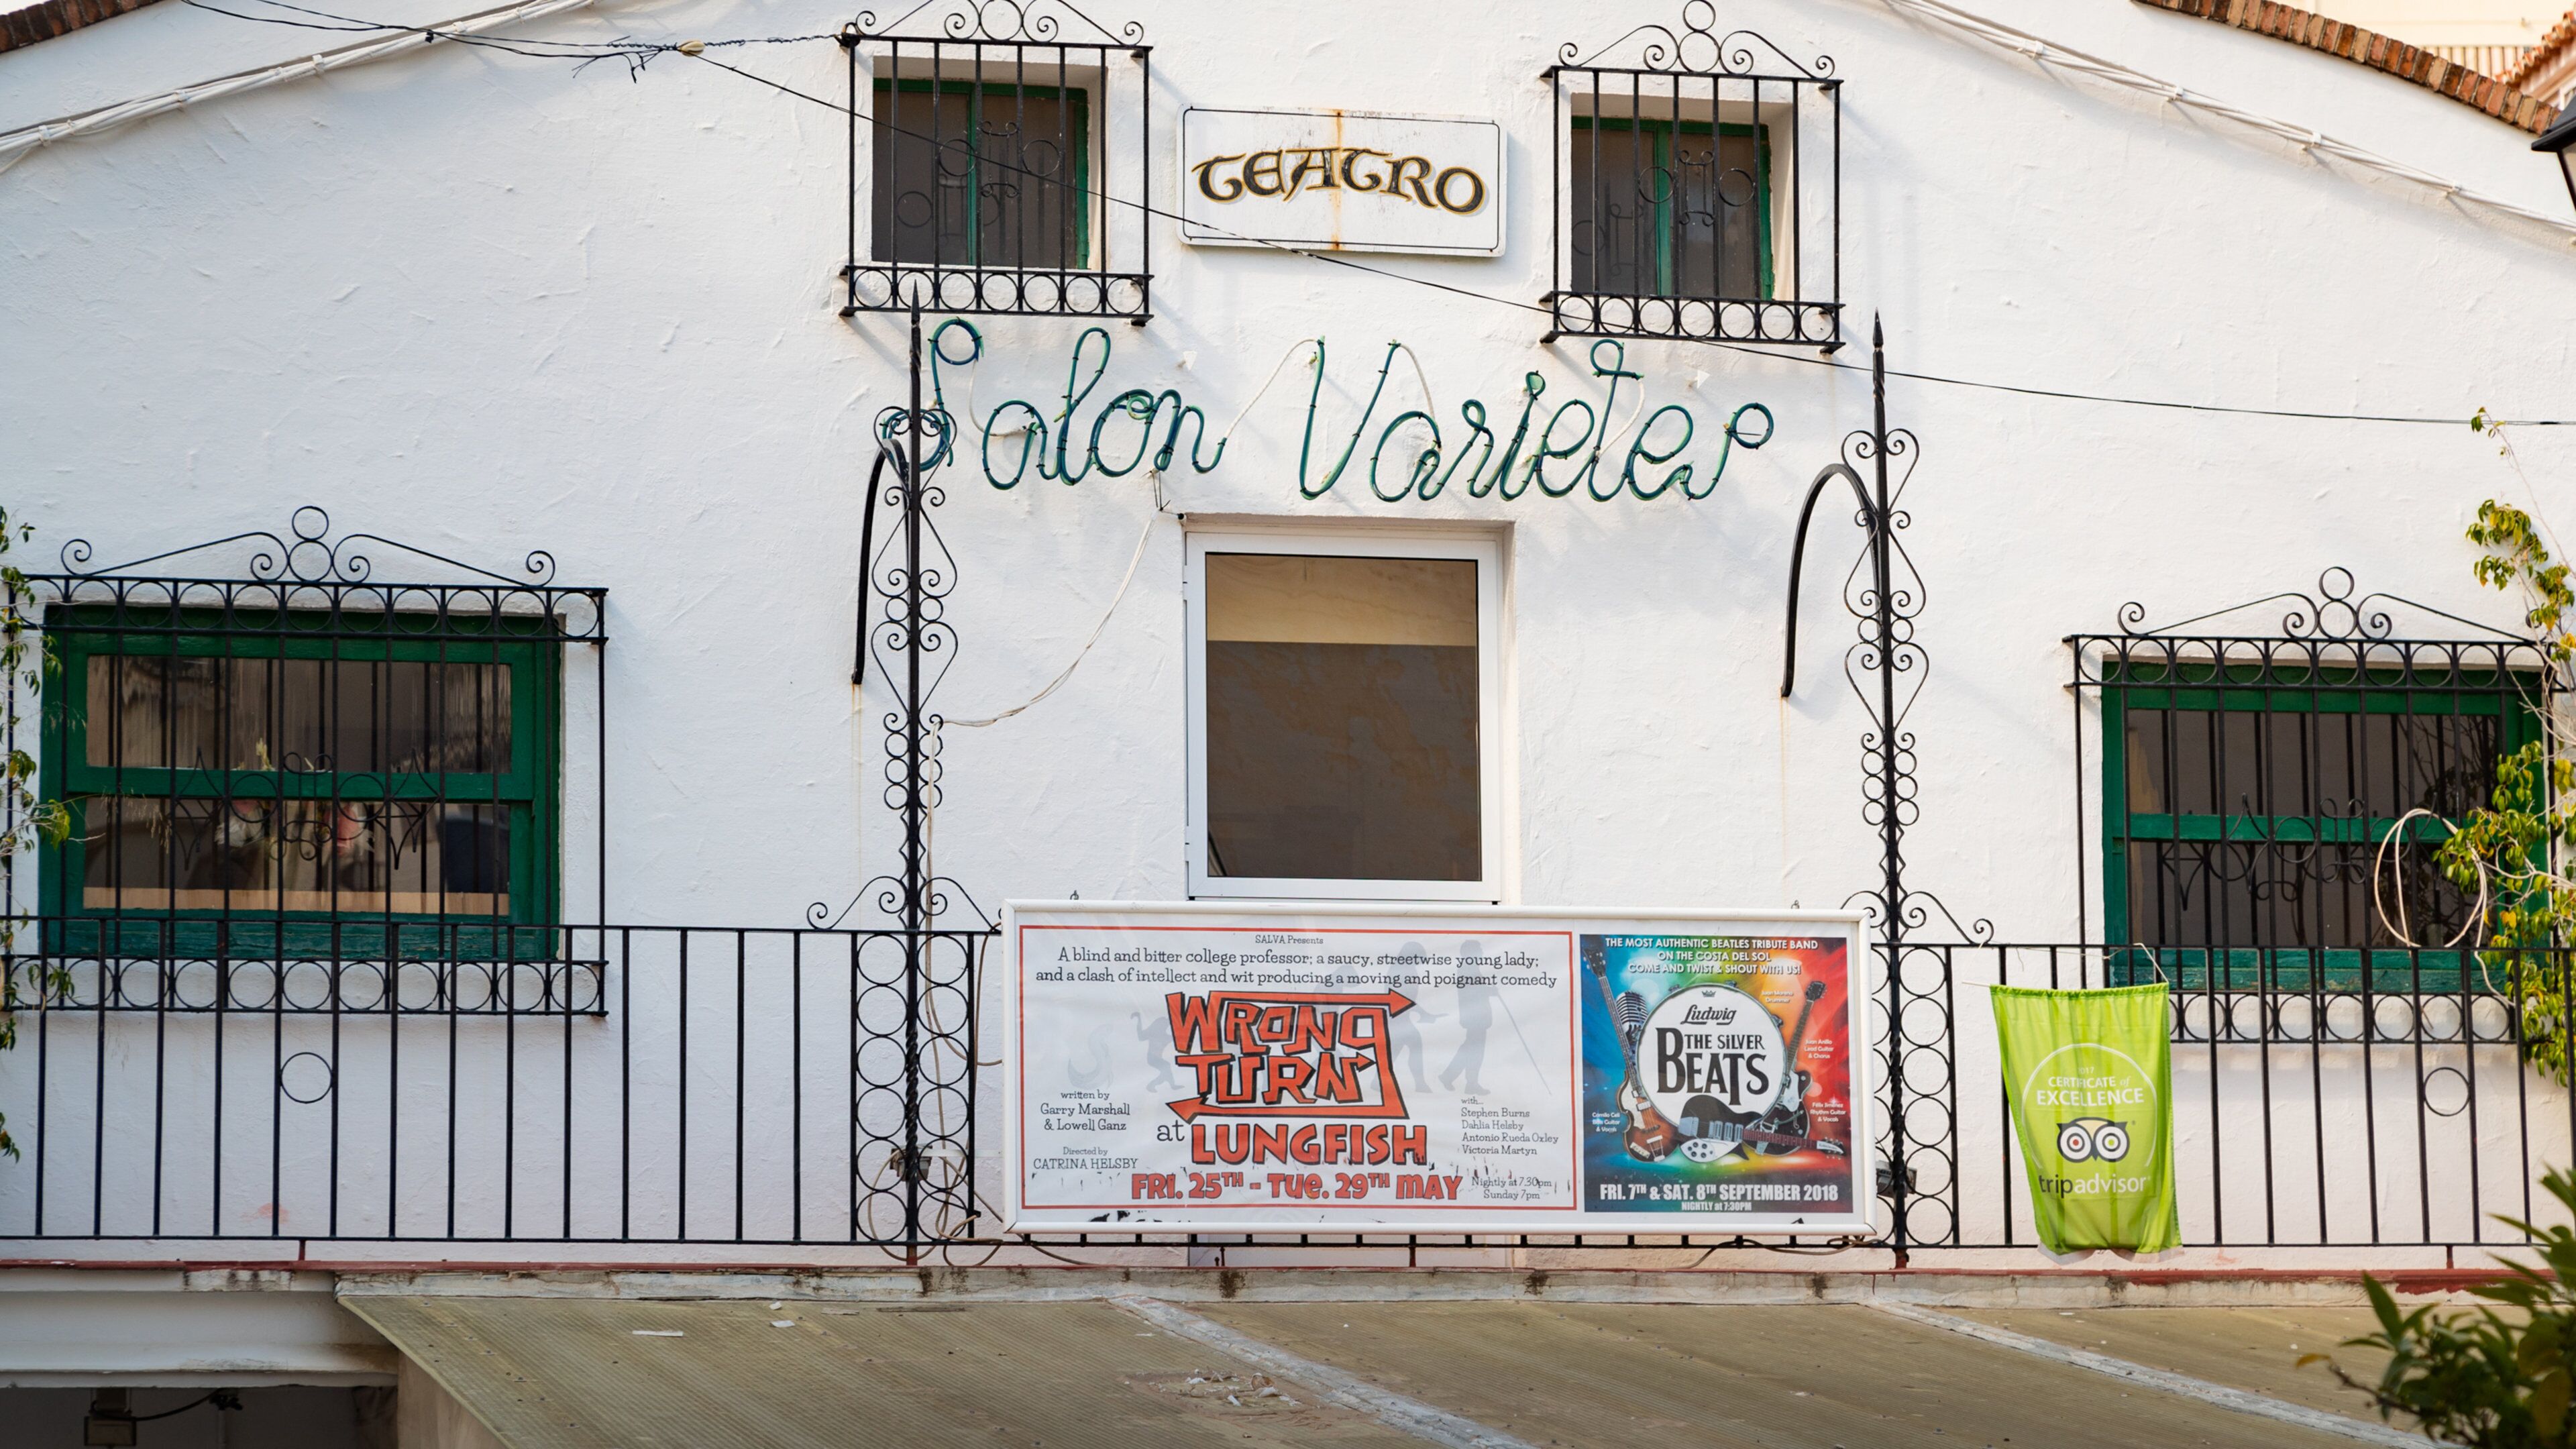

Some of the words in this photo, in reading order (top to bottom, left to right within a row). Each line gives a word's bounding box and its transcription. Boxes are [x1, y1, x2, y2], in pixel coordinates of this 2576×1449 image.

[1191, 146, 1485, 215] TEATRO
[881, 317, 1228, 492] Salon
[1255, 934, 1285, 944] SALVA
[1287, 936, 1324, 945] Presents
[1606, 938, 1623, 947] THE
[1625, 938, 1653, 947] MOST
[1656, 938, 1709, 948] AUTHENTIC
[1712, 939, 1750, 949] BEATLES
[1752, 940, 1787, 949] TRIBUTE
[1790, 941, 1818, 949] BAND
[1058, 948, 1069, 962] A
[1073, 947, 1110, 962] blind
[1114, 949, 1140, 962] and
[1144, 948, 1182, 963] bitter
[1185, 949, 1236, 967] college
[1240, 949, 1313, 966] professor;
[1316, 956, 1325, 965] a
[1328, 955, 1373, 969] saucy,
[1377, 953, 1452, 966] streetwise
[1456, 956, 1503, 969] young
[1505, 952, 1538, 969] lady;
[1658, 951, 1674, 960] ON
[1676, 952, 1693, 961] THE
[1696, 952, 1729, 961] COSTA
[1732, 953, 1750, 961] DEL
[1752, 953, 1770, 961] SOL
[1628, 964, 1660, 973] COME
[1662, 964, 1684, 973] AND
[1686, 964, 1714, 973] TWIST
[1725, 965, 1758, 973] SHOUT
[1760, 965, 1784, 974] WITH
[1787, 965, 1801, 975] US!
[1036, 968, 1063, 981] and
[1066, 973, 1075, 982] a
[1077, 969, 1114, 983] clash
[1118, 969, 1135, 983] of
[1136, 969, 1196, 983] intellect
[1199, 970, 1227, 984] and
[1231, 970, 1254, 984] wit
[1257, 970, 1334, 987] producing
[1336, 976, 1344, 985] a
[1347, 972, 1402, 988] moving
[1403, 971, 1431, 985] and
[1434, 972, 1497, 989] poignant
[1500, 973, 1557, 989] comedy
[1680, 1004, 1737, 1025] Ludwig
[1684, 1034, 1712, 1049] THE
[1656, 1027, 1770, 1106] BEATS
[1175, 1051, 1377, 1106] TURN
[2048, 1076, 2116, 1088] CERTIFICATE
[2120, 1075, 2131, 1086] of
[1061, 1089, 1095, 1099] written
[1097, 1089, 1110, 1101] by
[2037, 1088, 2144, 1106] EXCELLENCE
[1040, 1103, 1075, 1116] Garry
[1079, 1104, 1130, 1116] Marshall
[1461, 1108, 1499, 1118] Stephen
[1501, 1108, 1529, 1117] Burns
[1044, 1119, 1054, 1130] &
[1057, 1119, 1095, 1131] Lowell
[1097, 1120, 1127, 1131] Ganz
[1462, 1120, 1490, 1129] Dahlia
[1493, 1120, 1523, 1131] Helsby
[1157, 1120, 1185, 1142] at
[1191, 1124, 1428, 1165] LUNGFISH
[1462, 1132, 1500, 1142] Antonio
[1502, 1132, 1530, 1142] Rueda
[1532, 1133, 1558, 1144] Oxley
[1063, 1147, 1097, 1155] Directed
[1097, 1147, 1108, 1157] by
[1462, 1145, 1499, 1154] Victoria
[1501, 1146, 1537, 1156] Martyn
[1034, 1159, 1088, 1169] CATRINA
[1091, 1159, 1138, 1169] HELSBY
[1132, 1174, 1183, 1199] FRI.
[1189, 1172, 1244, 1199] 25TH
[1335, 1173, 1391, 1199] 29TH
[1472, 1177, 1506, 1188] Nightly
[1509, 1178, 1517, 1187] at
[2039, 1173, 2147, 1198] tripadvisor
[1483, 1190, 1519, 1201] Sunday
[1521, 1190, 1540, 1201] 7pm
[1600, 1184, 1625, 1200] FRI.
[1629, 1185, 1646, 1199] 7TH
[1650, 1187, 1661, 1200] &
[1663, 1184, 1693, 1200] SAT.
[1697, 1185, 1716, 1199] 8TH
[1719, 1184, 1800, 1201] SEPTEMBER
[1804, 1185, 1838, 1201] 2018
[1682, 1202, 1713, 1211] NIGHTLY
[1715, 1202, 1723, 1211] at
[1723, 1202, 1752, 1211] 7:30PM
